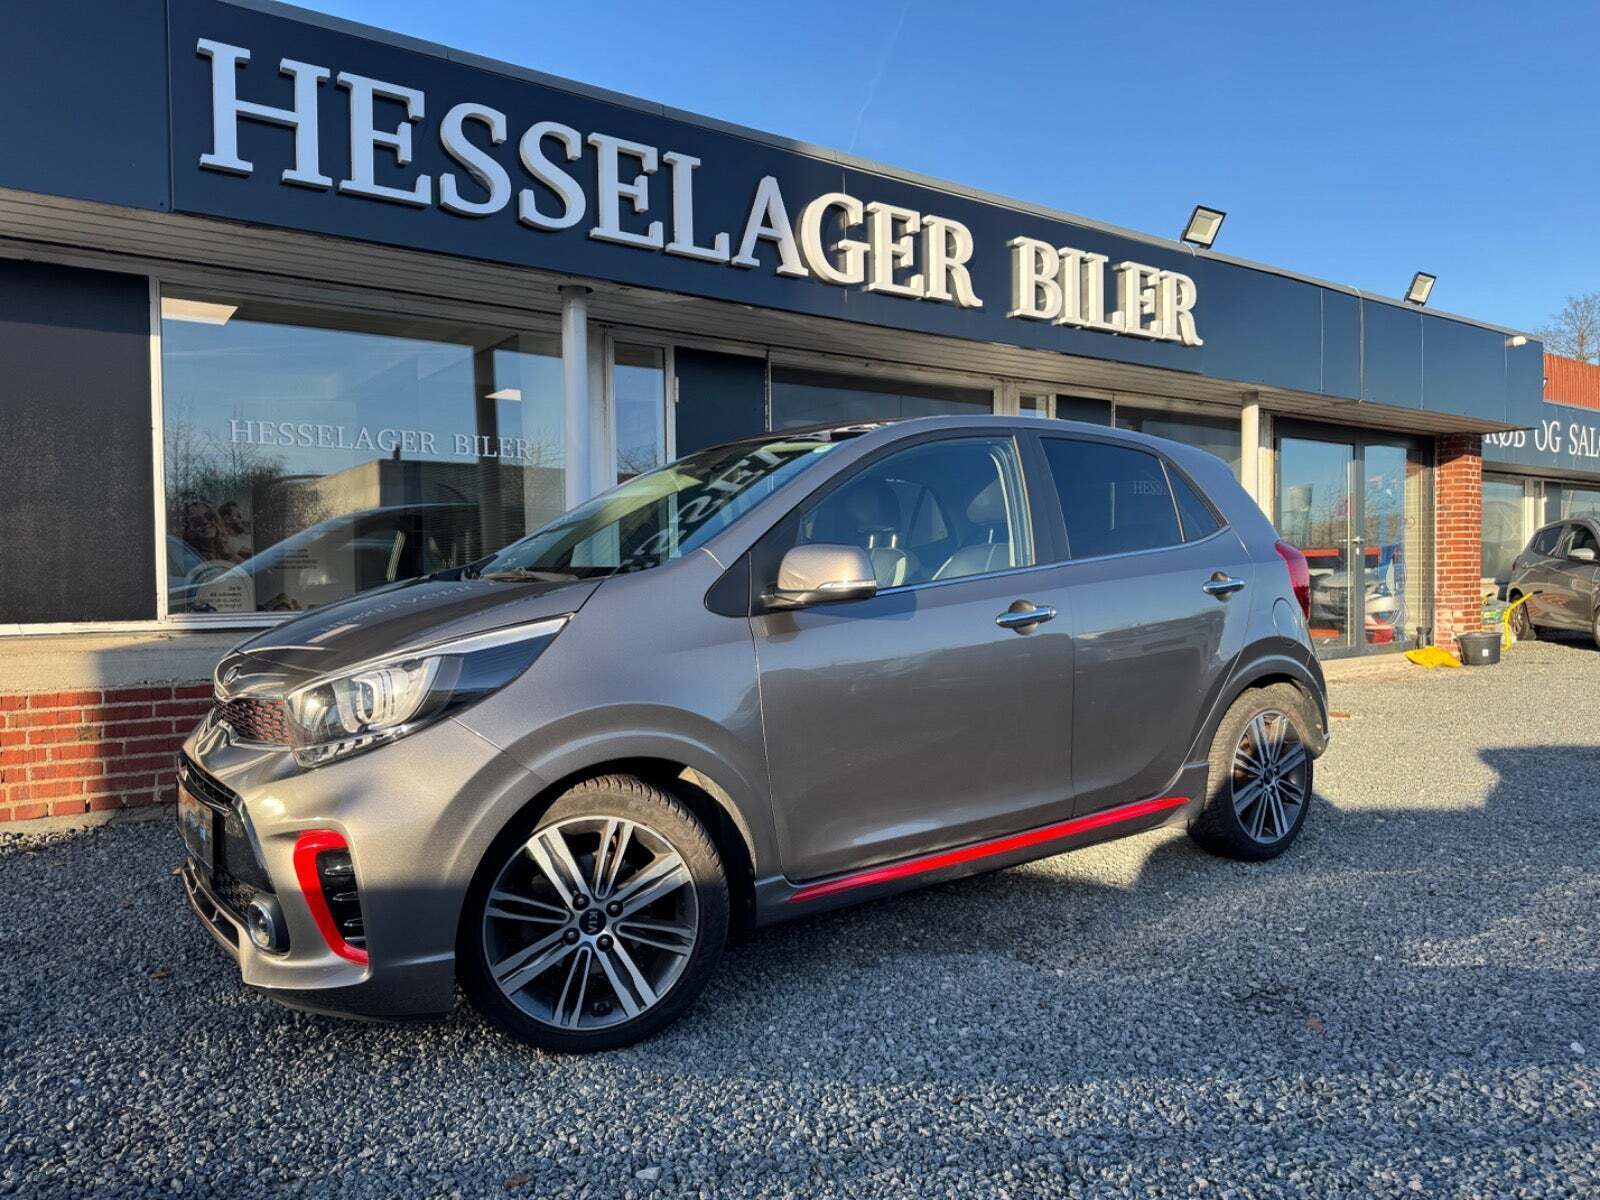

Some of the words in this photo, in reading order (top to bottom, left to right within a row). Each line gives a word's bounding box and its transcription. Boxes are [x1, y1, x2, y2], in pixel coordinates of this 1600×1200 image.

[196, 37, 983, 308] HESSELAGER
[1009, 236, 1203, 346] BILER
[229, 419, 438, 454] HESSELAGER
[453, 432, 533, 460] BILER
[1534, 419, 1562, 453] OG
[1568, 423, 1600, 457] SAL
